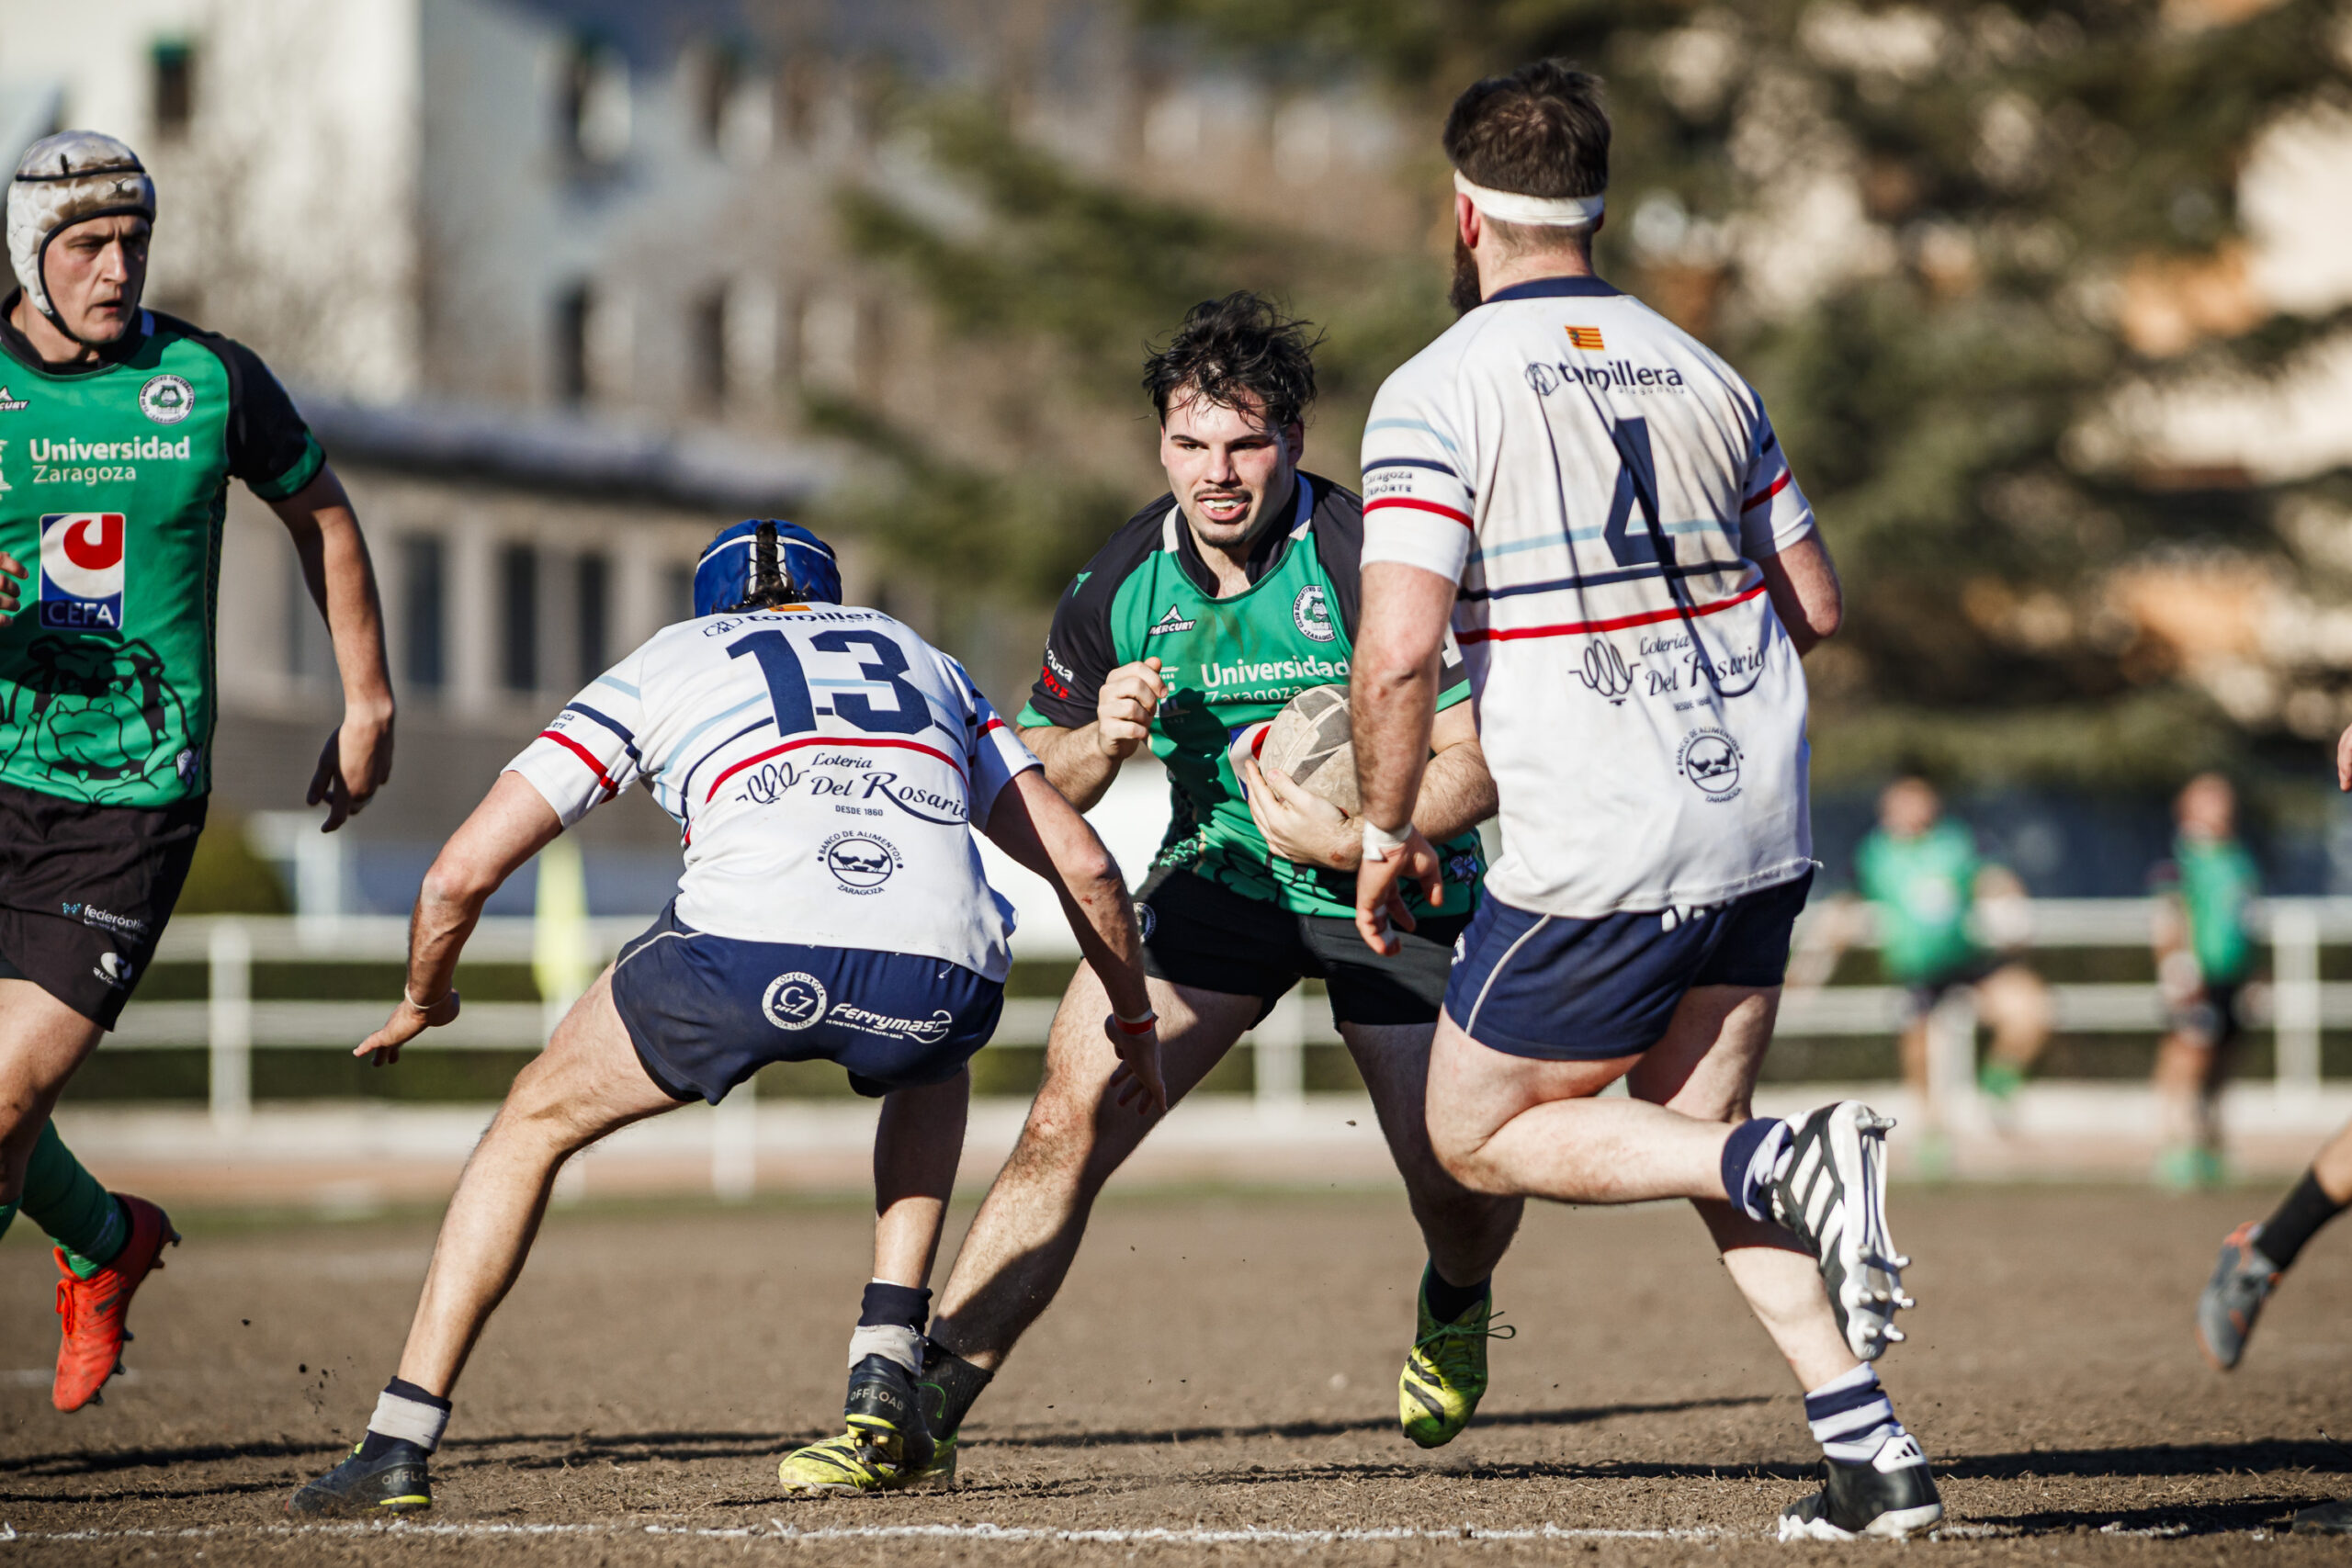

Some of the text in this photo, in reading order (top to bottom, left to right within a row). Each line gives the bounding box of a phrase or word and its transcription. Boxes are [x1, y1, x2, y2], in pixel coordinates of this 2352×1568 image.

[0, 400, 28, 411] CURY
[29, 436, 191, 462] Universidad
[32, 465, 137, 486] Zaragoza
[1602, 417, 1676, 567] 4
[48, 602, 115, 626] CEFA
[1148, 620, 1195, 635] MERCURY
[1200, 655, 1351, 688] Universidad
[1645, 667, 1679, 695] Del
[725, 629, 933, 738] 13
[811, 752, 873, 769] Loteria
[810, 772, 969, 825] Del Rosario
[835, 805, 884, 817] DESDE 1860
[818, 833, 841, 854] BANCO
[856, 830, 902, 862] ALIMENTOS
[837, 883, 886, 895] ZARAGOZA
[850, 1388, 904, 1411] OFFLOAD
[381, 1470, 425, 1485] OFFLO
